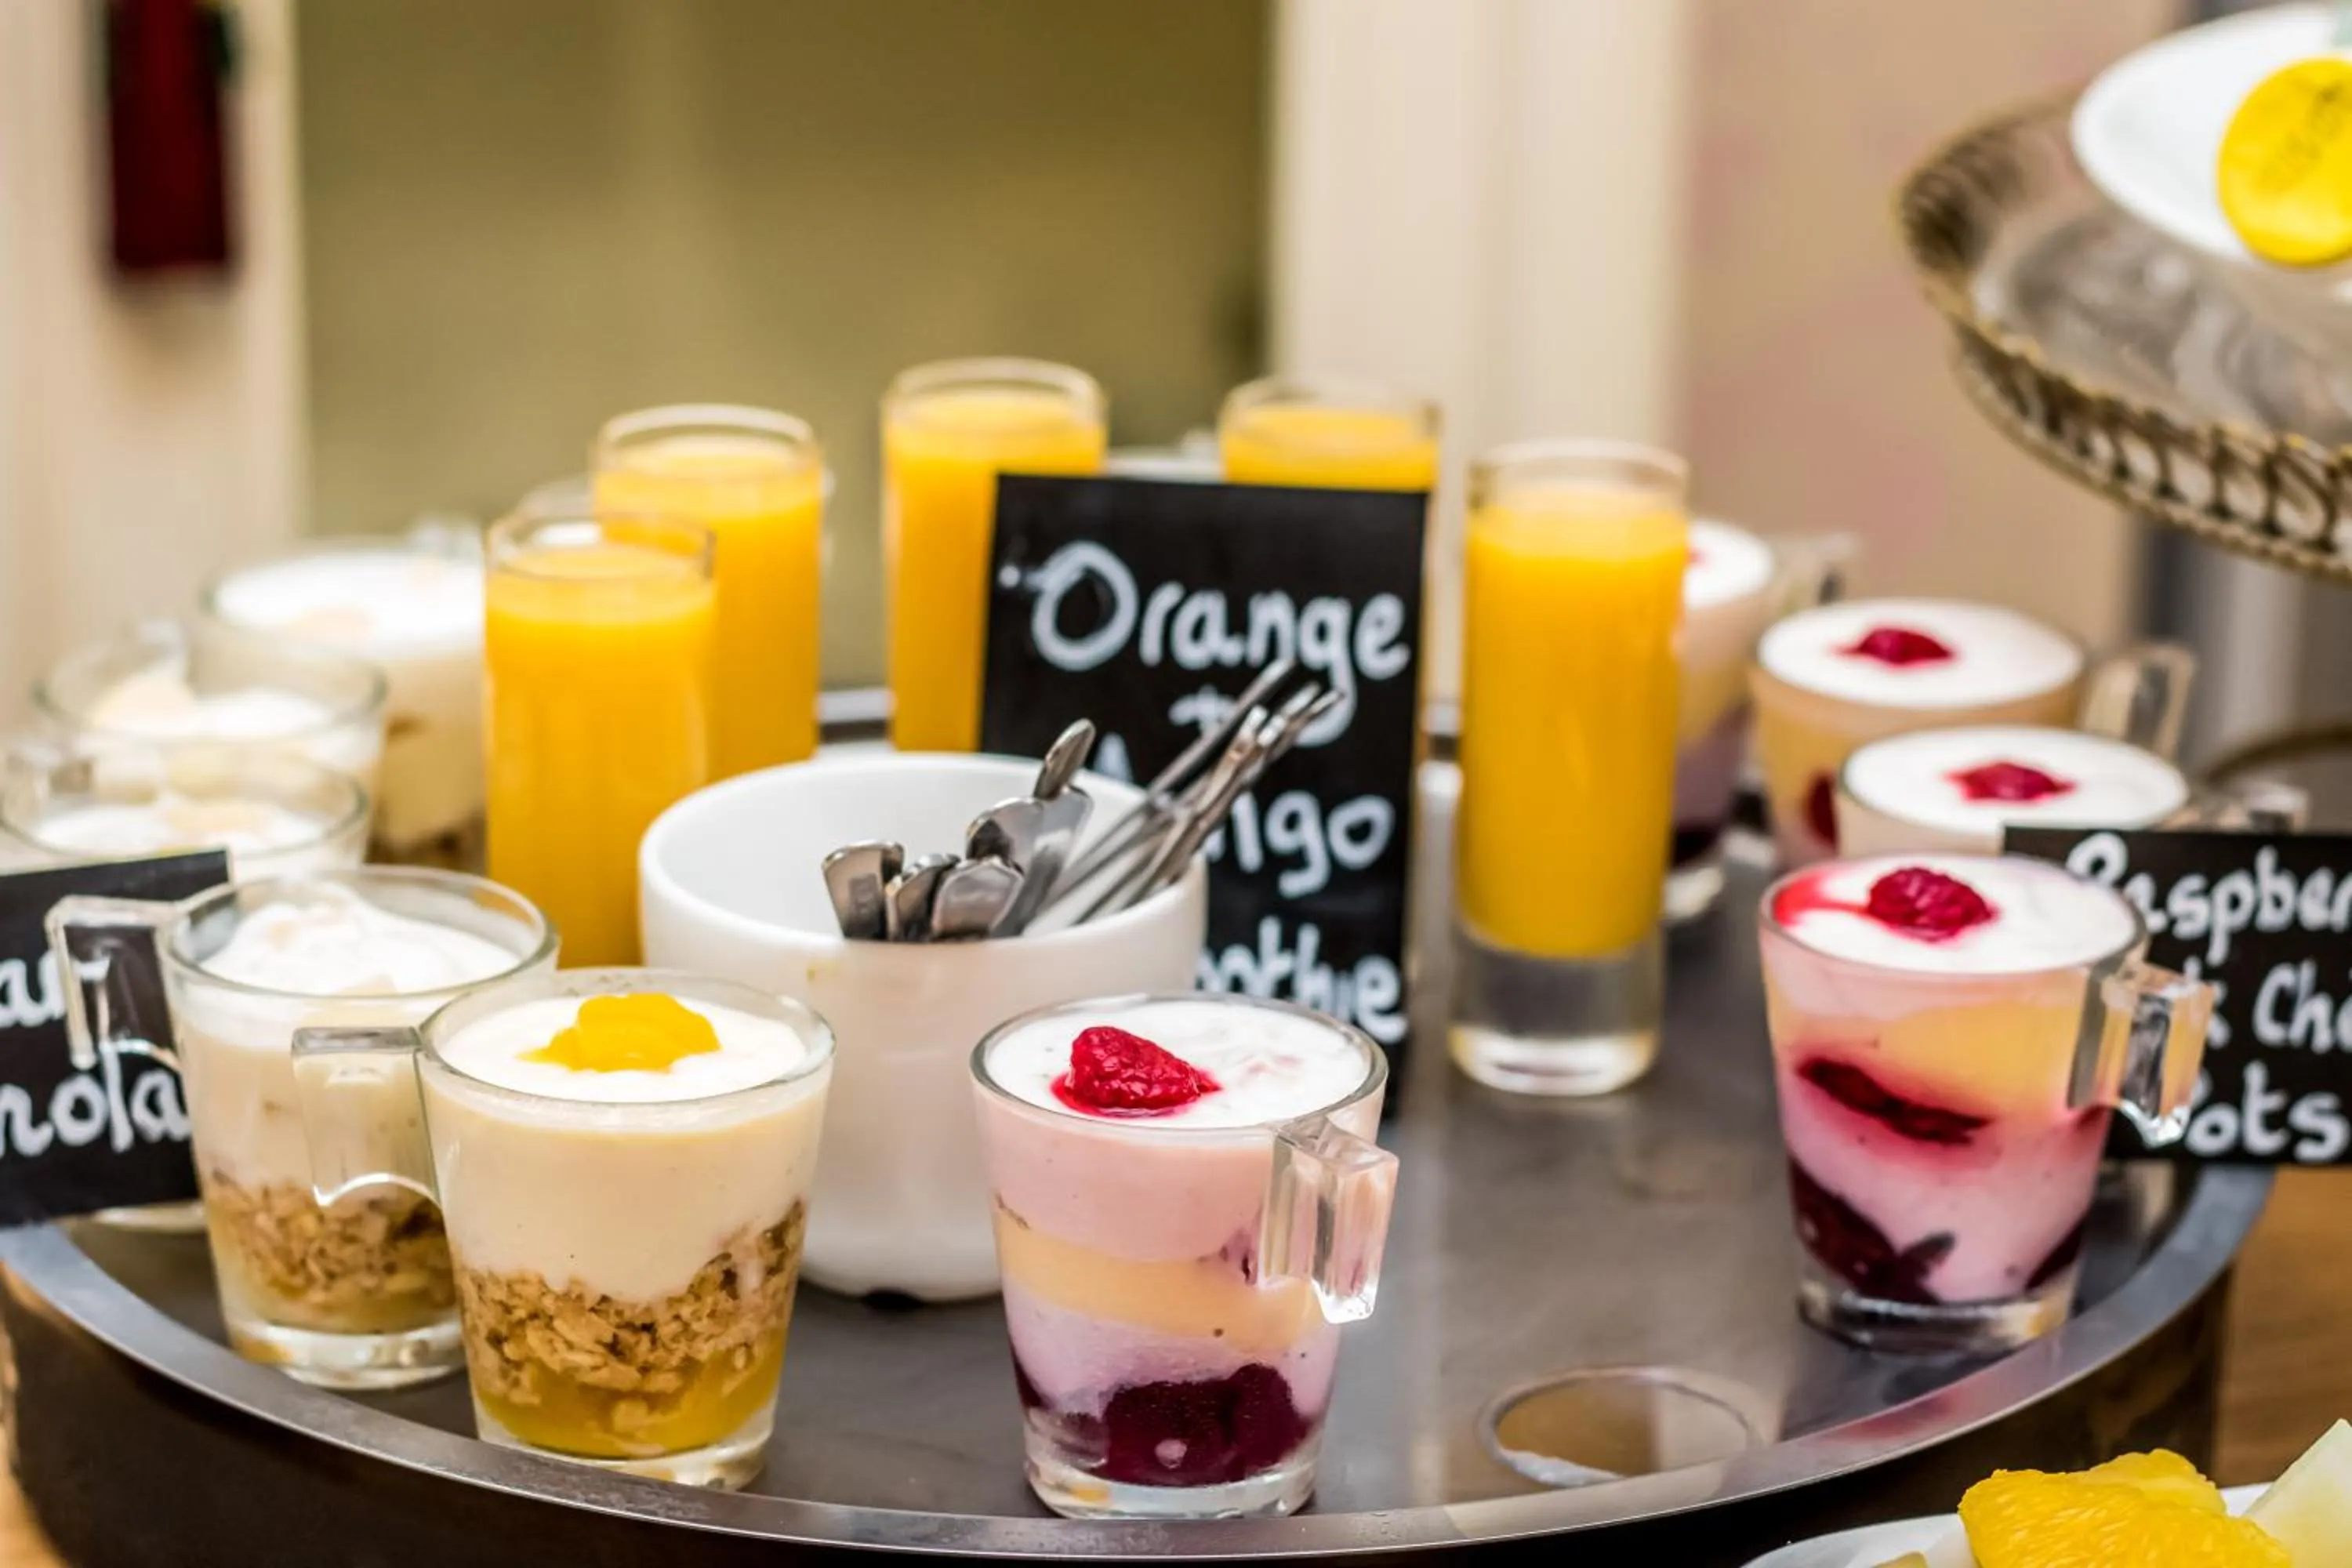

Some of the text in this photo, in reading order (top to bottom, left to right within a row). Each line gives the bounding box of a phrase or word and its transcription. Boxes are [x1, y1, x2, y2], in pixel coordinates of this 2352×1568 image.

[1029, 539, 1410, 748] Orange
[2251, 957, 2352, 1055] Ch
[2183, 1058, 2351, 1163] ots
